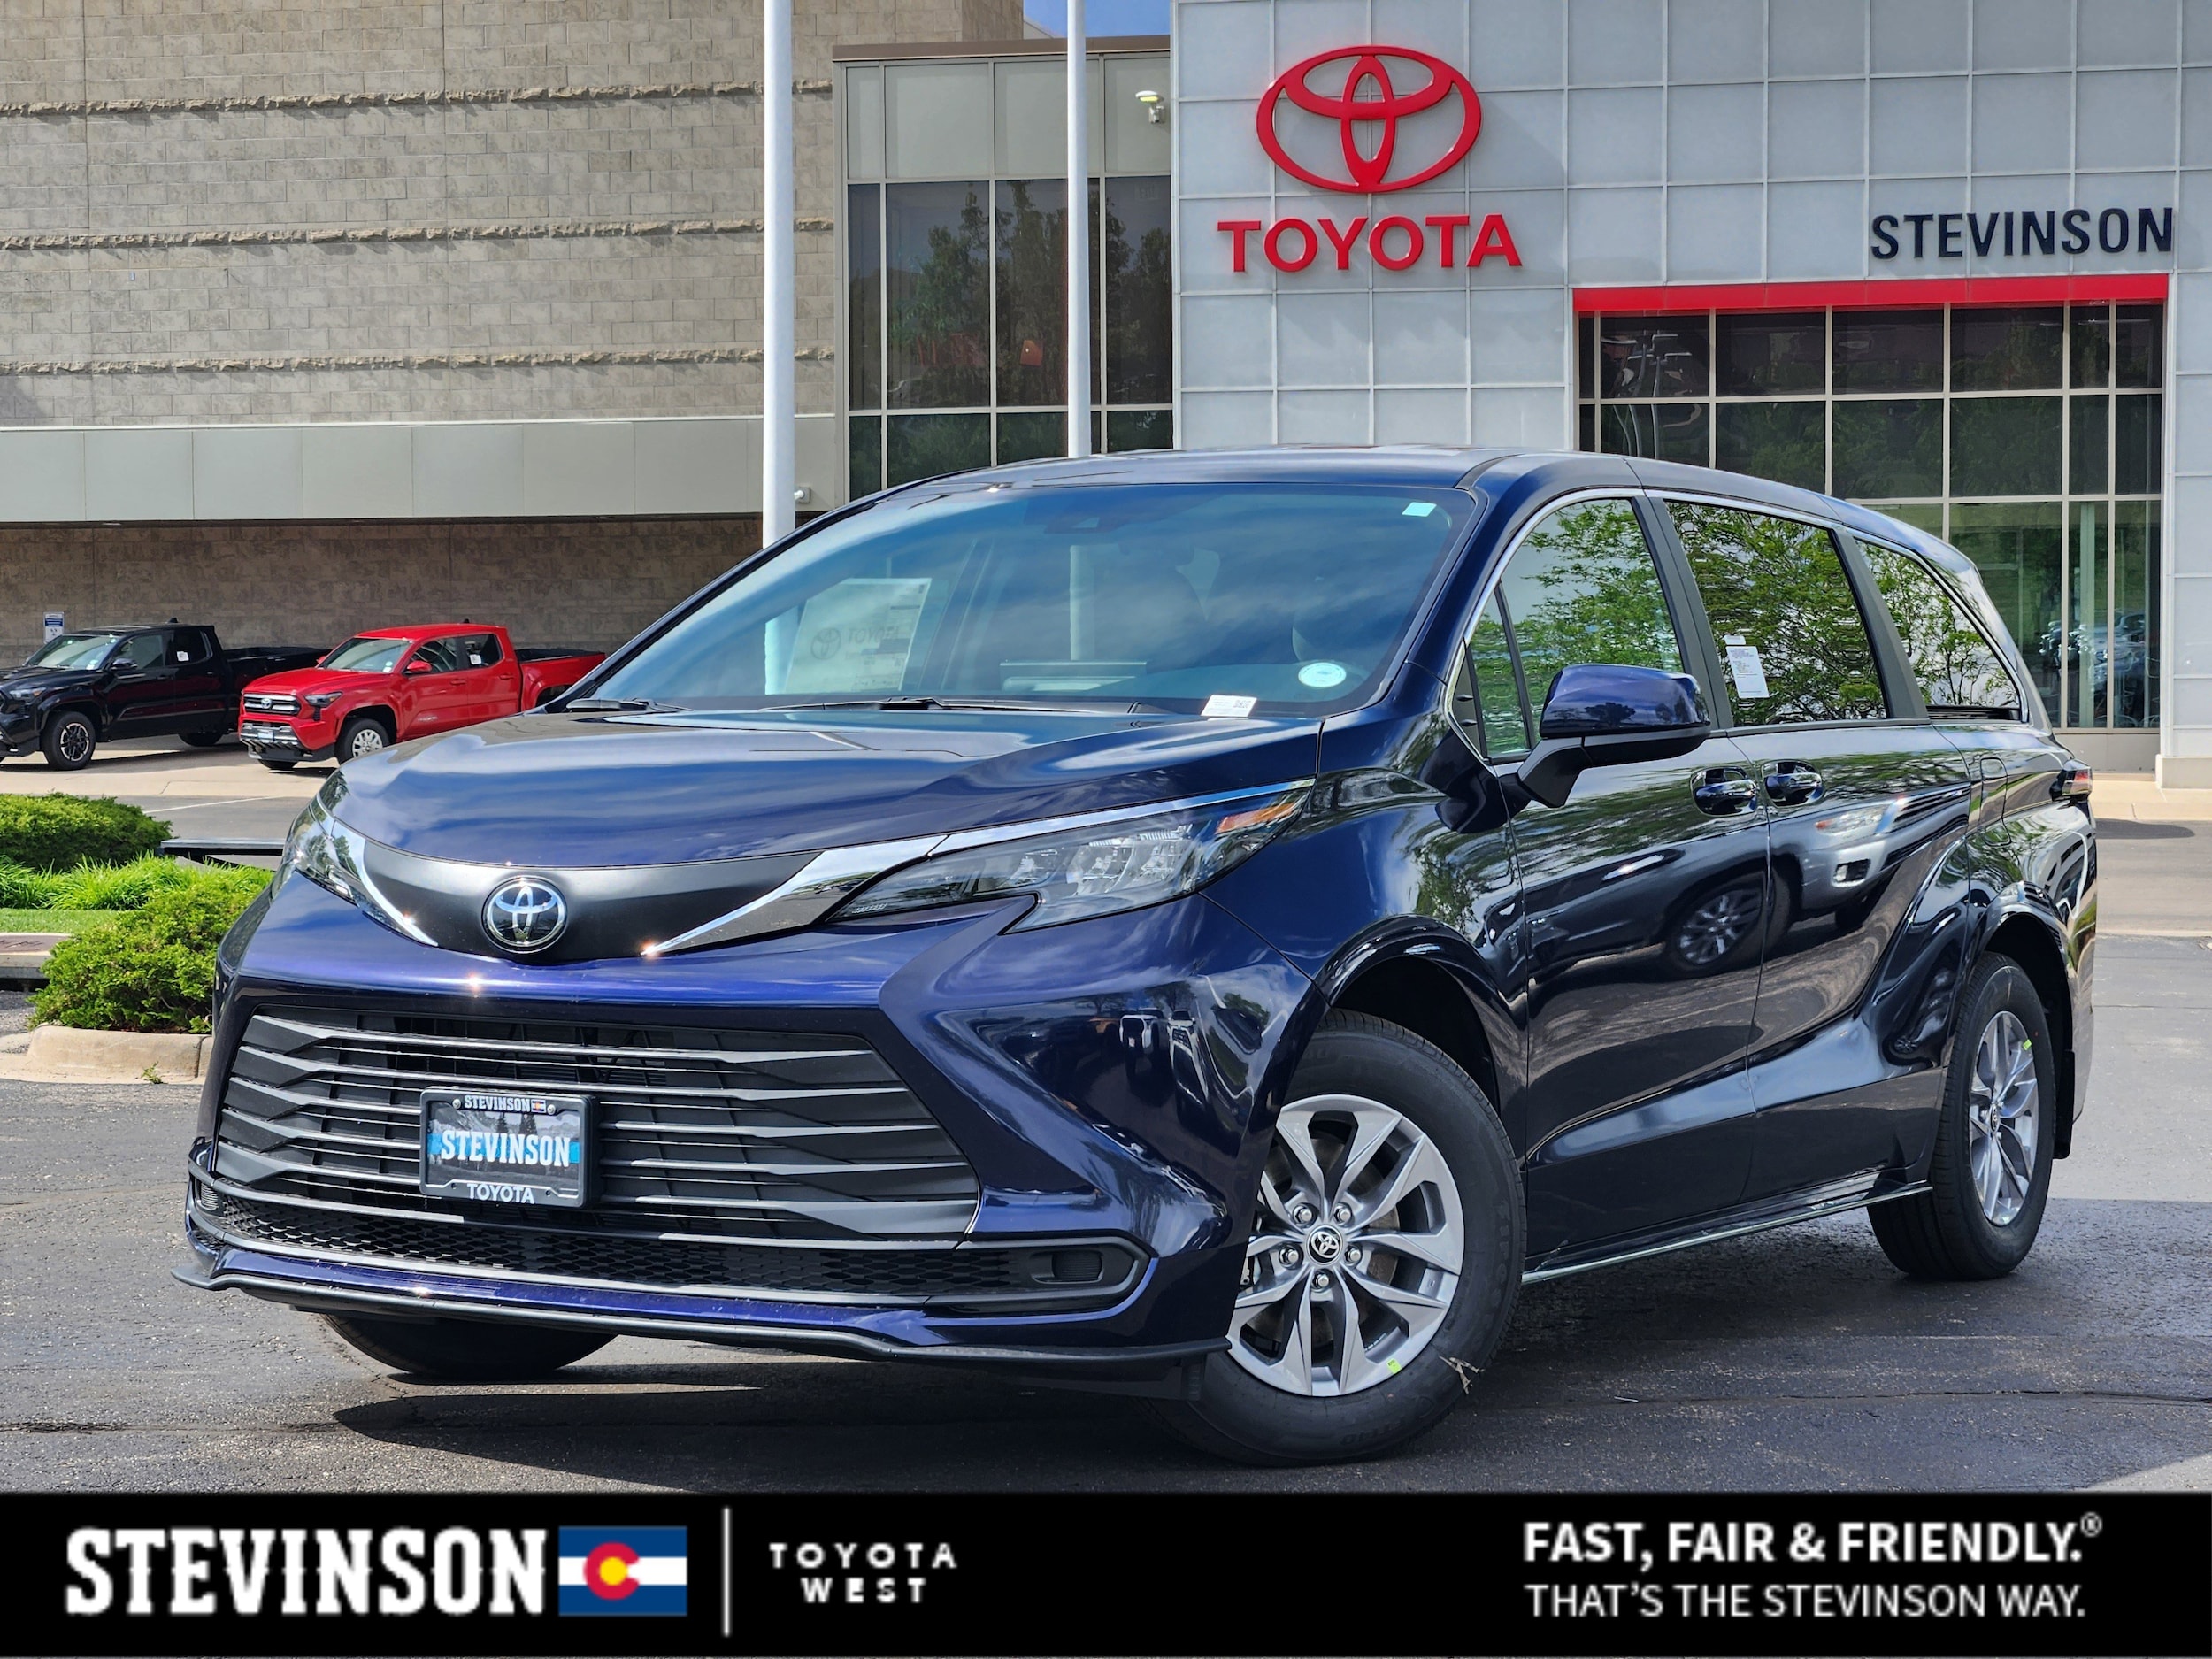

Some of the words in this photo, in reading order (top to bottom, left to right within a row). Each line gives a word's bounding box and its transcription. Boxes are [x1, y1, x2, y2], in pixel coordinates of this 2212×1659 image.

[1217, 214, 1522, 273] TOYOTA
[1870, 207, 2174, 260] STEVINSON
[464, 1094, 531, 1112] STEVINSON
[441, 1129, 571, 1167] STEVINSON
[466, 1182, 535, 1204] TOYOTA
